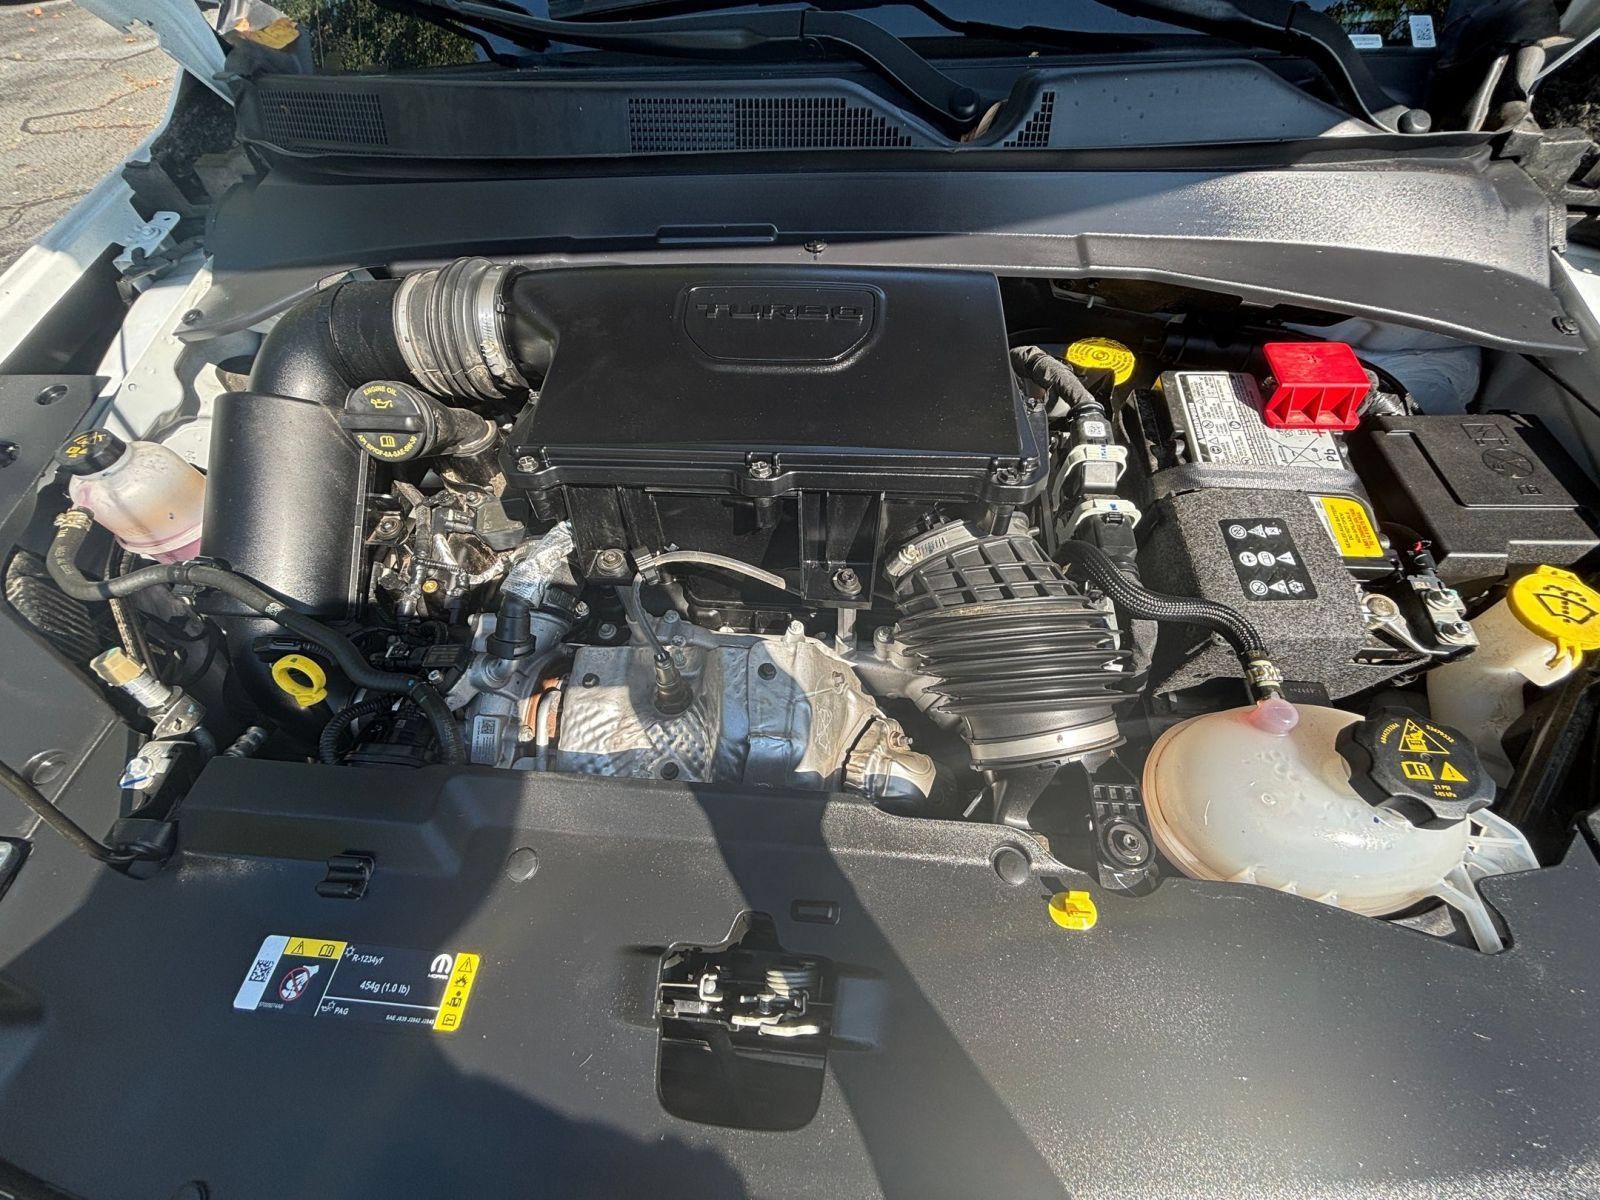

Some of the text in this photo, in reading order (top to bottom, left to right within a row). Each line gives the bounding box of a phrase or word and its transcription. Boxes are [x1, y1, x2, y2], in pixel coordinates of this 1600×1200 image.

[696, 304, 864, 320] TURBO
[363, 385, 398, 397] ENGINE OIL
[1324, 448, 1340, 462] Pb
[351, 953, 384, 966] R-1234yf
[360, 980, 411, 996] 454g (1.0 lb)
[333, 1006, 349, 1015] PAG
